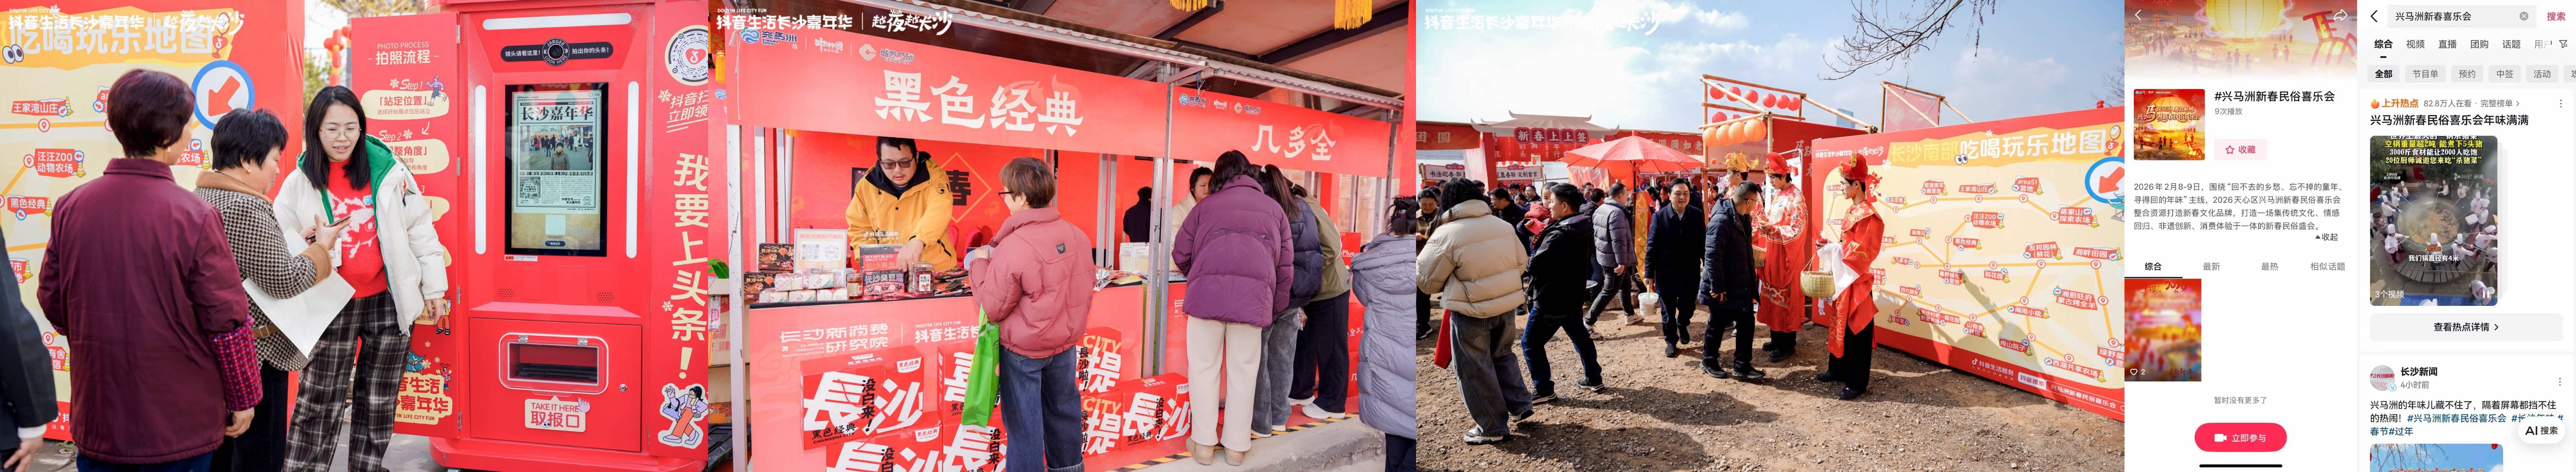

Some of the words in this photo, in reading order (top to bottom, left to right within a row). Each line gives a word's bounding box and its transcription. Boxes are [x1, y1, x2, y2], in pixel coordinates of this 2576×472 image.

[2395, 12, 2472, 21] 兴马洲新春喜乐会
[2546, 12, 2566, 21] 搜索
[9, 19, 213, 55] 吃喝玩乐地图
[2374, 39, 2393, 49] 综合
[2406, 40, 2425, 49] 视频
[2438, 40, 2457, 49] 直播
[2470, 40, 2489, 49] 团购
[2502, 40, 2521, 49] 话题
[376, 50, 431, 66] 拍照流程
[544, 55, 556, 65] LOOK
[556, 55, 568, 64] HERE
[880, 48, 914, 62] 城发文旅
[2375, 69, 2393, 78] 全部
[2412, 70, 2439, 78] 节目单
[2458, 70, 2476, 78] 预约
[2496, 70, 2514, 78] 中签
[2533, 70, 2551, 78] 活动
[399, 79, 419, 92] Step
[2214, 91, 2336, 102] #兴马洲新春民俗喜乐会
[13, 102, 58, 113] 王家湾山庄
[874, 69, 1083, 138] 黑色经典
[2381, 98, 2419, 108] 上升热点
[2423, 99, 2472, 108] 82.8万人在看
[2480, 99, 2513, 108] 完整榜单
[521, 106, 593, 121] 长沙嘉年华
[2215, 107, 2243, 116] 9次播放
[2370, 115, 2529, 126] 兴马洲新春民俗喜乐会年味满满
[379, 130, 396, 143] Step
[1517, 130, 1587, 143] 新春上上签
[1251, 124, 1336, 161] 几多全
[1960, 129, 2105, 160] 吃喝玩乐地图
[1890, 141, 1959, 163] 长沙南部
[2238, 145, 2256, 155] 收藏
[37, 151, 73, 162] 汪汪ZOO
[37, 163, 73, 174] 动物农场
[11, 198, 46, 209] 黑色经典
[2134, 209, 2340, 218] 整合资源打造新春文化品牌，打造一场集传统文化、情感
[1972, 219, 1997, 228] 动物农场
[2059, 215, 2090, 224] 探索农场
[2134, 222, 2320, 231] 回归、非遗创新、消费体验于一体的新春民俗盛会。
[2322, 233, 2339, 241] 收起
[2075, 248, 2107, 258] 湘畔田园
[670, 152, 708, 379] 我要上头条！
[2145, 262, 2162, 271] 综合
[2203, 262, 2220, 271] 最新
[2261, 262, 2278, 271] 最热
[2310, 262, 2346, 271] 相似话题
[864, 273, 905, 285] 长沙臭豆腐
[1985, 271, 2003, 280] 稻花园
[1900, 287, 1919, 296] 四方朋友
[2061, 291, 2093, 302] 湘厨旺府
[2375, 290, 2404, 298] 3个视频
[2057, 297, 2096, 309] 蒙古烤全羊
[2014, 306, 2042, 318] 闻雨小院
[1966, 322, 1984, 331] 山有舍
[2434, 322, 2490, 332] 查看热点详情
[826, 336, 888, 353] 研究院
[1083, 335, 1122, 354] CITY
[2000, 340, 2026, 351] 梅山院子
[899, 360, 920, 368] 黑色经典
[1979, 361, 2014, 376] 抖音生活服务
[2053, 359, 2099, 377] 西湖共享农场
[2400, 366, 2438, 376] 长沙新闻
[2020, 375, 2045, 387] 抖音搜索
[2400, 381, 2430, 389] 4小时前
[2051, 384, 2117, 409] 兴马洲新春民俗喜乐会
[2214, 396, 2267, 405] 暂时没有更多了
[531, 402, 550, 411] TAKE
[559, 404, 579, 413] HERE
[861, 378, 877, 432] 没白来！
[1083, 398, 1122, 415] CITY
[2370, 400, 2557, 410] 兴马洲的年味儿藏不住了，隔着屏幕都挡不住
[530, 411, 580, 428] 取报口
[2370, 413, 2401, 423] 的热闹！
[2407, 413, 2507, 424] #兴马洲新春民俗喜乐会
[811, 423, 856, 439] 黑色经典
[917, 429, 938, 437] 黑色经典
[2370, 427, 2413, 436] 春节#过年
[2525, 426, 2538, 435] AI
[2540, 426, 2559, 435] 搜索
[813, 435, 843, 444] CHANGSHA
[1127, 431, 1152, 443] 黑色经典
[2232, 434, 2266, 443] 立即参与
